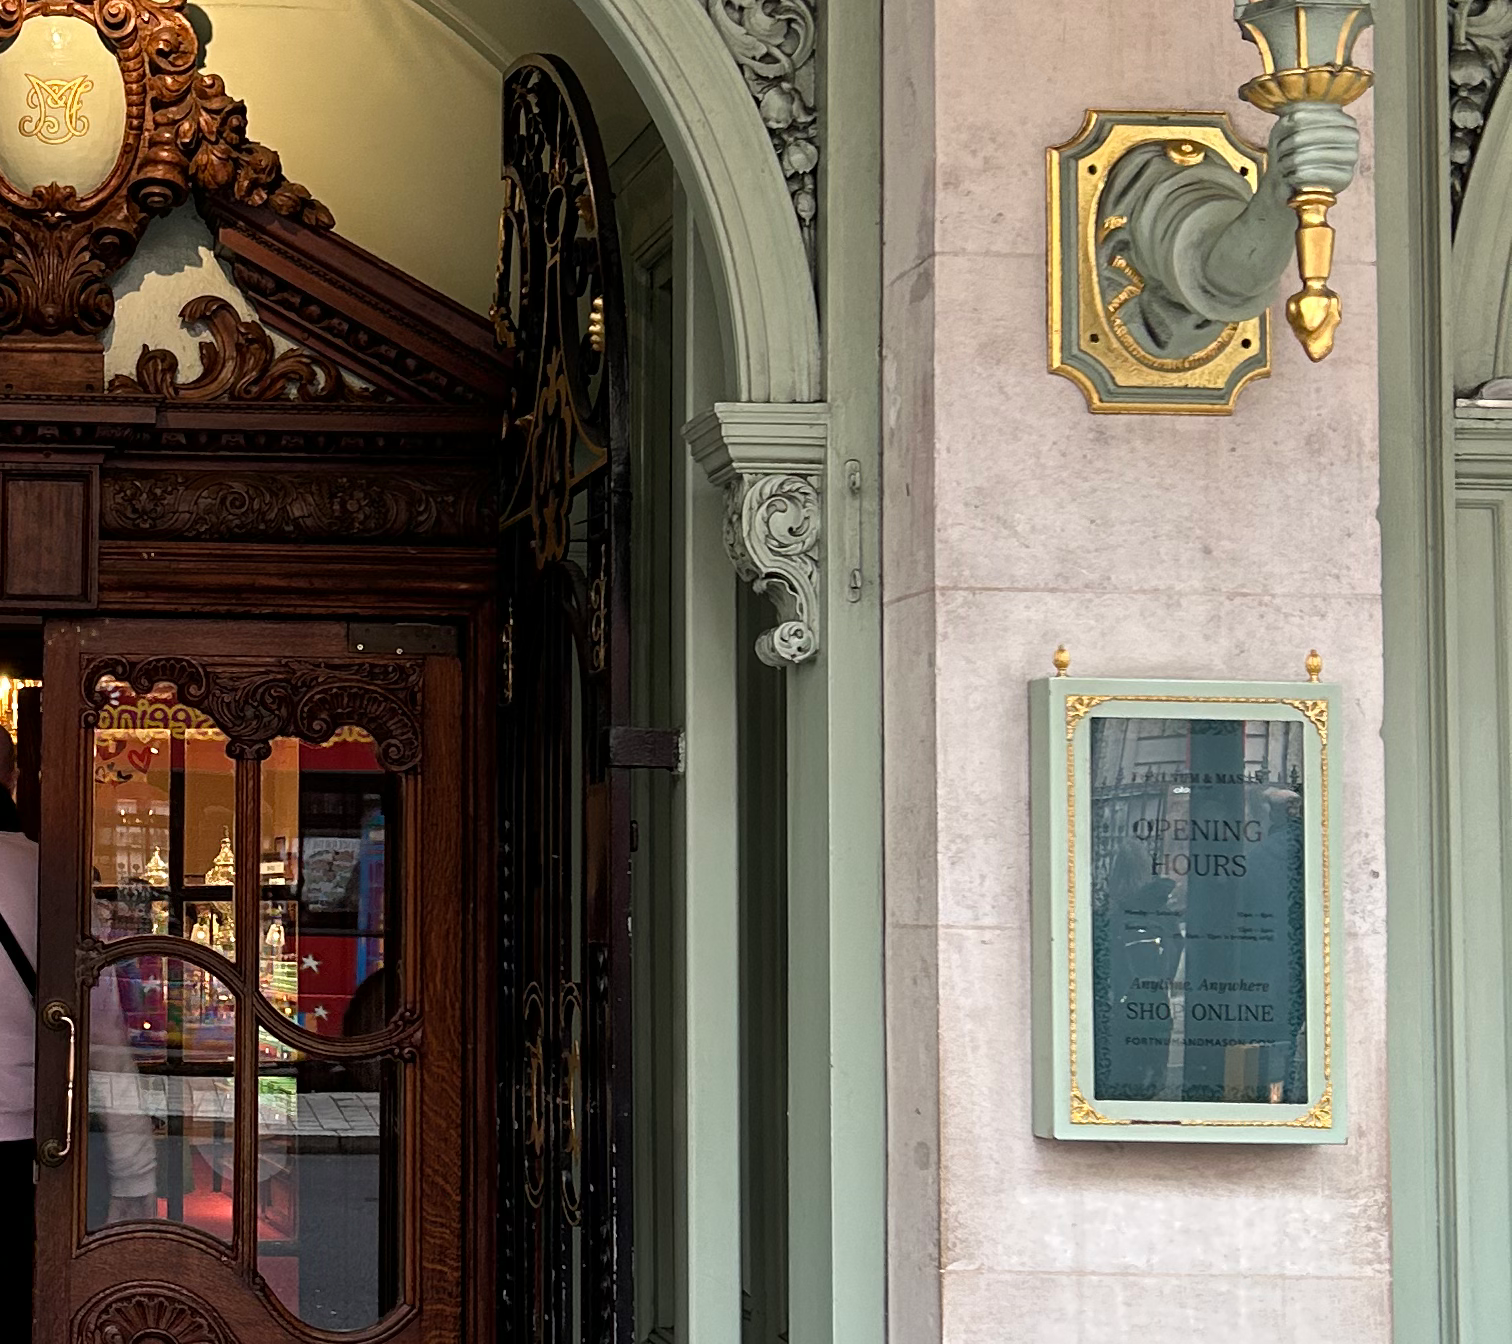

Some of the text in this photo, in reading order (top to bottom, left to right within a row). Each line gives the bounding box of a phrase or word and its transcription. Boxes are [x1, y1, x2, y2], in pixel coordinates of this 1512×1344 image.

[1133, 818, 1262, 842] OPENING
[1150, 853, 1248, 877] HOURS
[1198, 978, 1270, 995] Anywhere
[1192, 1003, 1274, 1022] ONLINE
